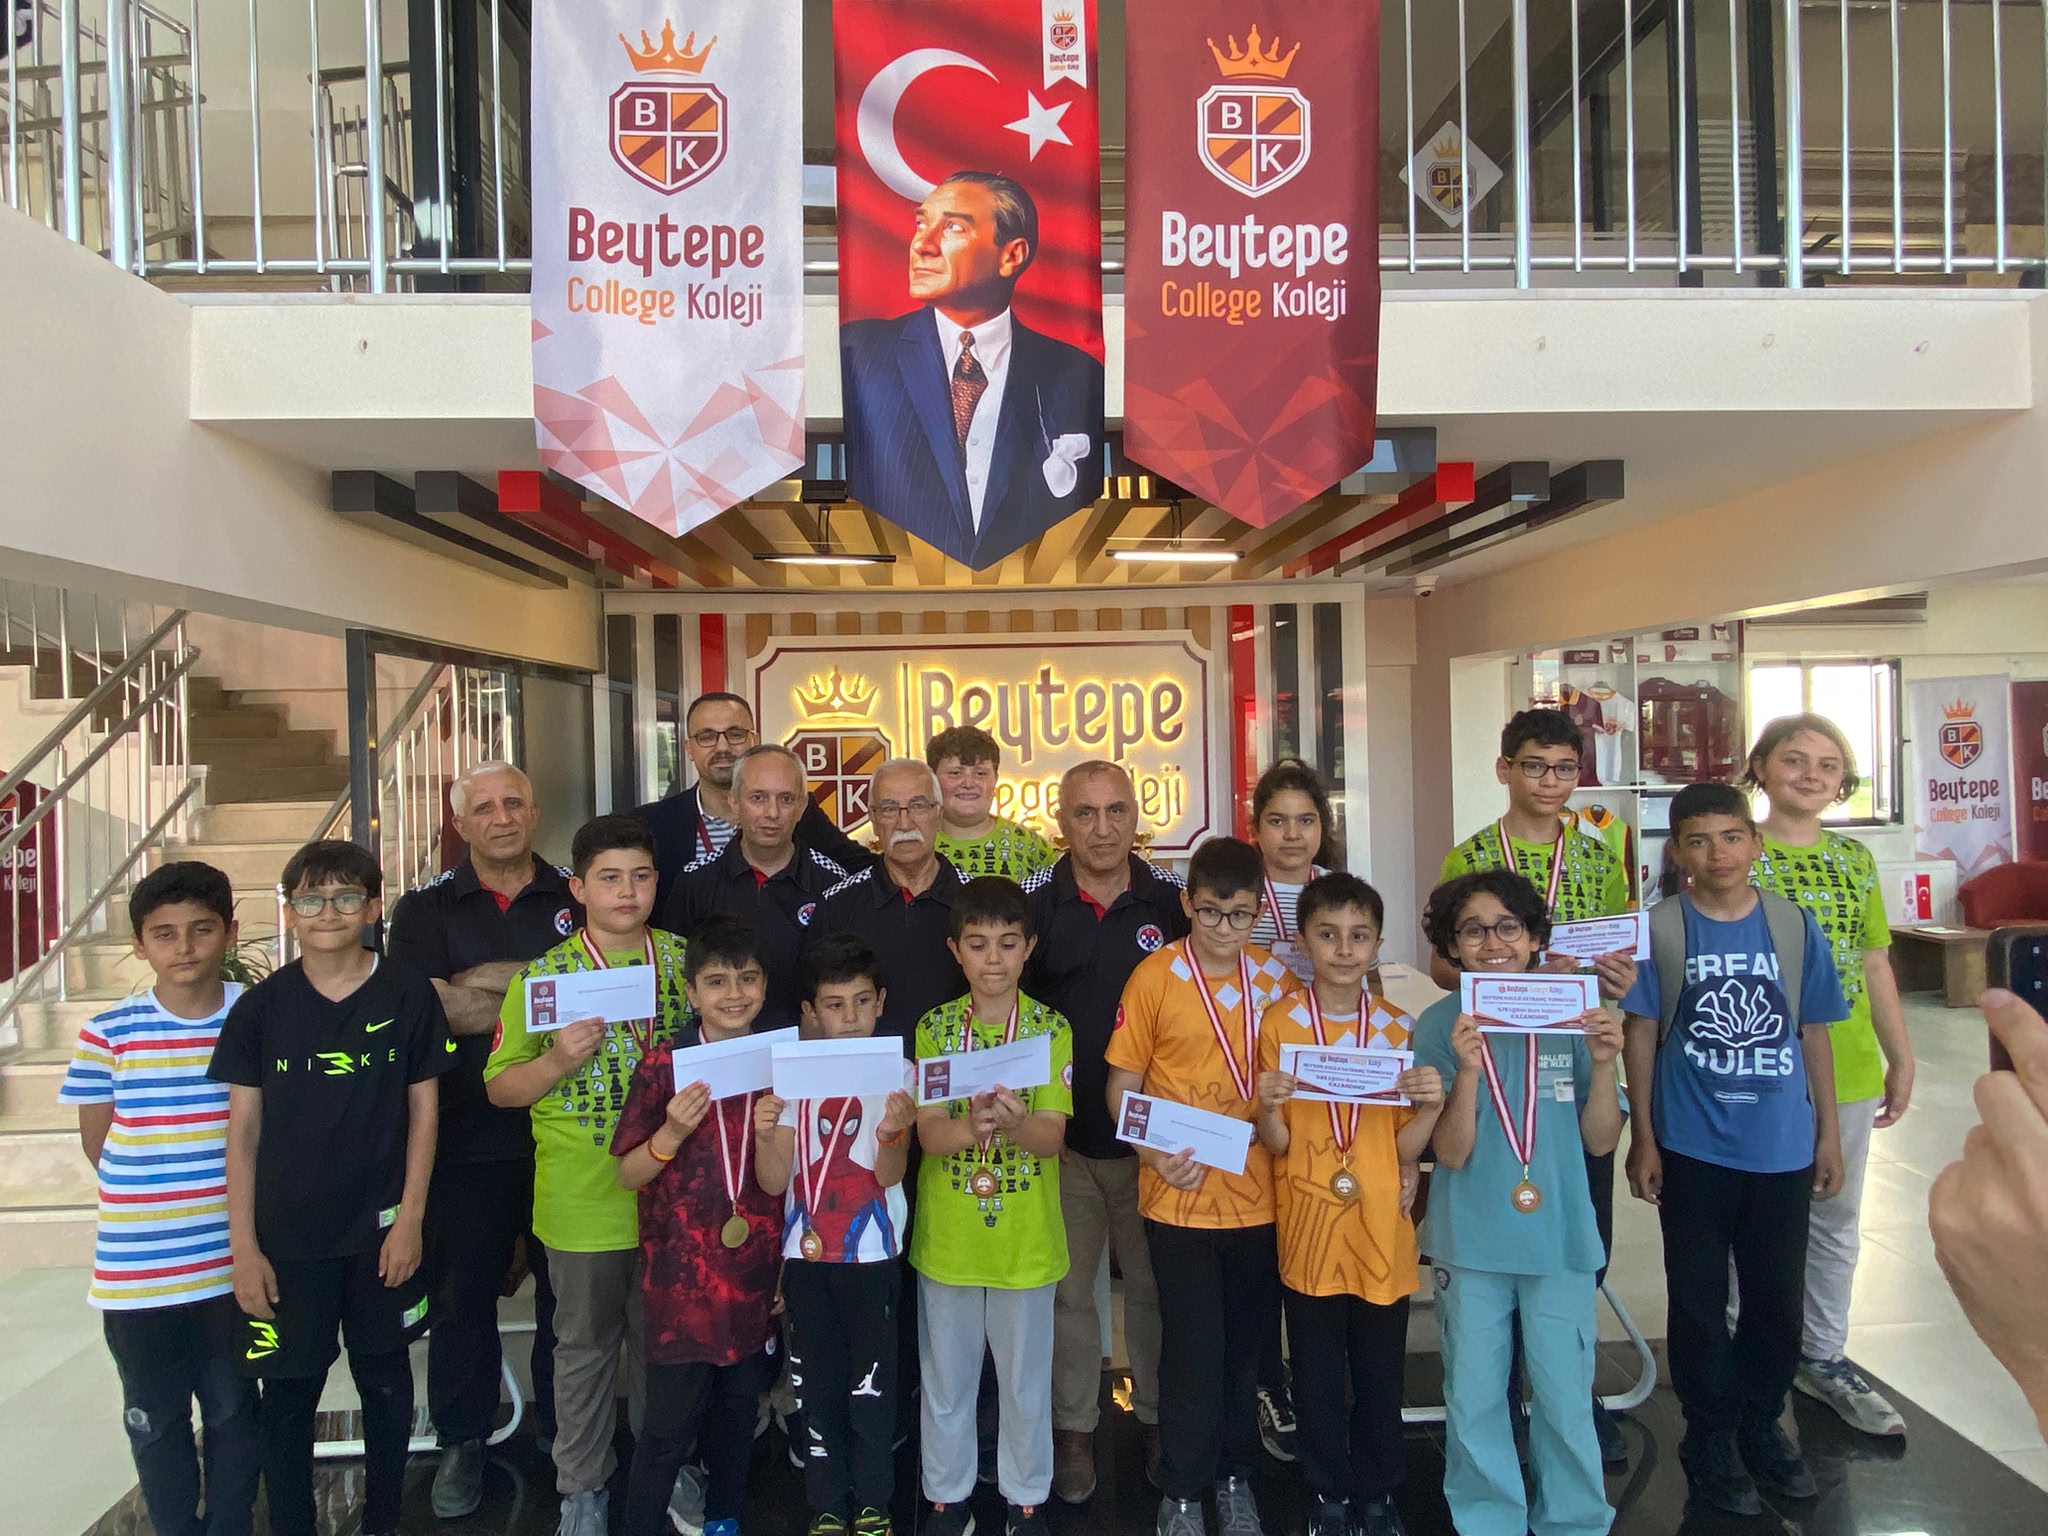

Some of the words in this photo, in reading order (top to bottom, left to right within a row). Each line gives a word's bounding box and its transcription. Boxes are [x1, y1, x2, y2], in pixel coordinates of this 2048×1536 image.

[634, 98, 657, 126] B
[1221, 102, 1242, 129] B
[675, 140, 700, 170] K
[1260, 143, 1284, 172] K
[568, 206, 764, 279] Beytepe
[1162, 211, 1348, 279] Beytepe
[567, 276, 675, 326] College
[687, 283, 762, 327] Koleji
[1161, 280, 1262, 326] College
[1272, 279, 1347, 322] Koleji
[921, 666, 1183, 763] Beytepe
[806, 743, 828, 772] B
[846, 783, 869, 813] K
[1928, 776, 2000, 804] Beytepe
[3, 873, 37, 893] Kleji
[1685, 953, 1779, 985] BREA
